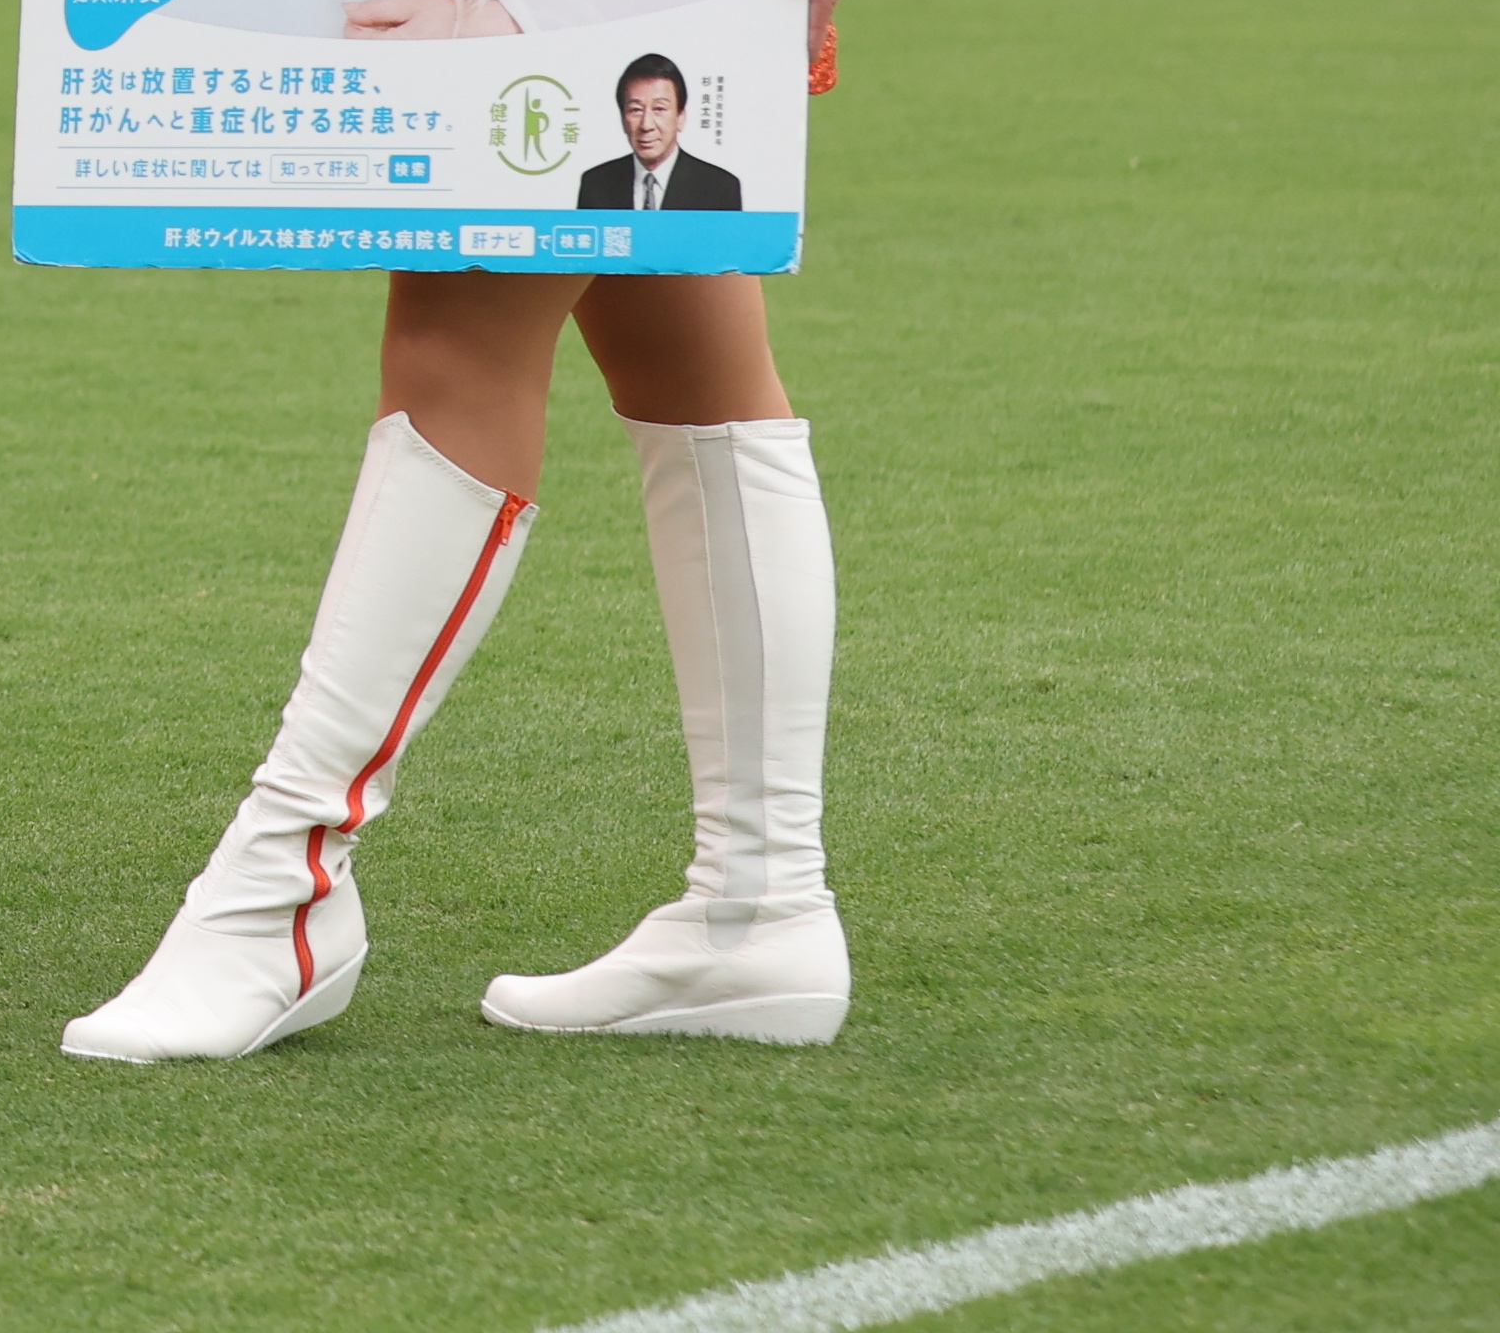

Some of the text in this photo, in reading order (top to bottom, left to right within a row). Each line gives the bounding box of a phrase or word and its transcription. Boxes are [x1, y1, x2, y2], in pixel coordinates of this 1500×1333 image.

[61, 67, 382, 94] 肝炎は放置すると肝硬変、
[59, 106, 453, 134] 肝がんへと重症化する疾患です。
[489, 103, 508, 146] 健康
[562, 108, 581, 144] 一番
[75, 159, 427, 179] 詳しい症状に関しては 知って肝炎 で 検索
[164, 226, 592, 251] 肝炎ウイルス検査ができる病院を 肝ナビ で 検索
